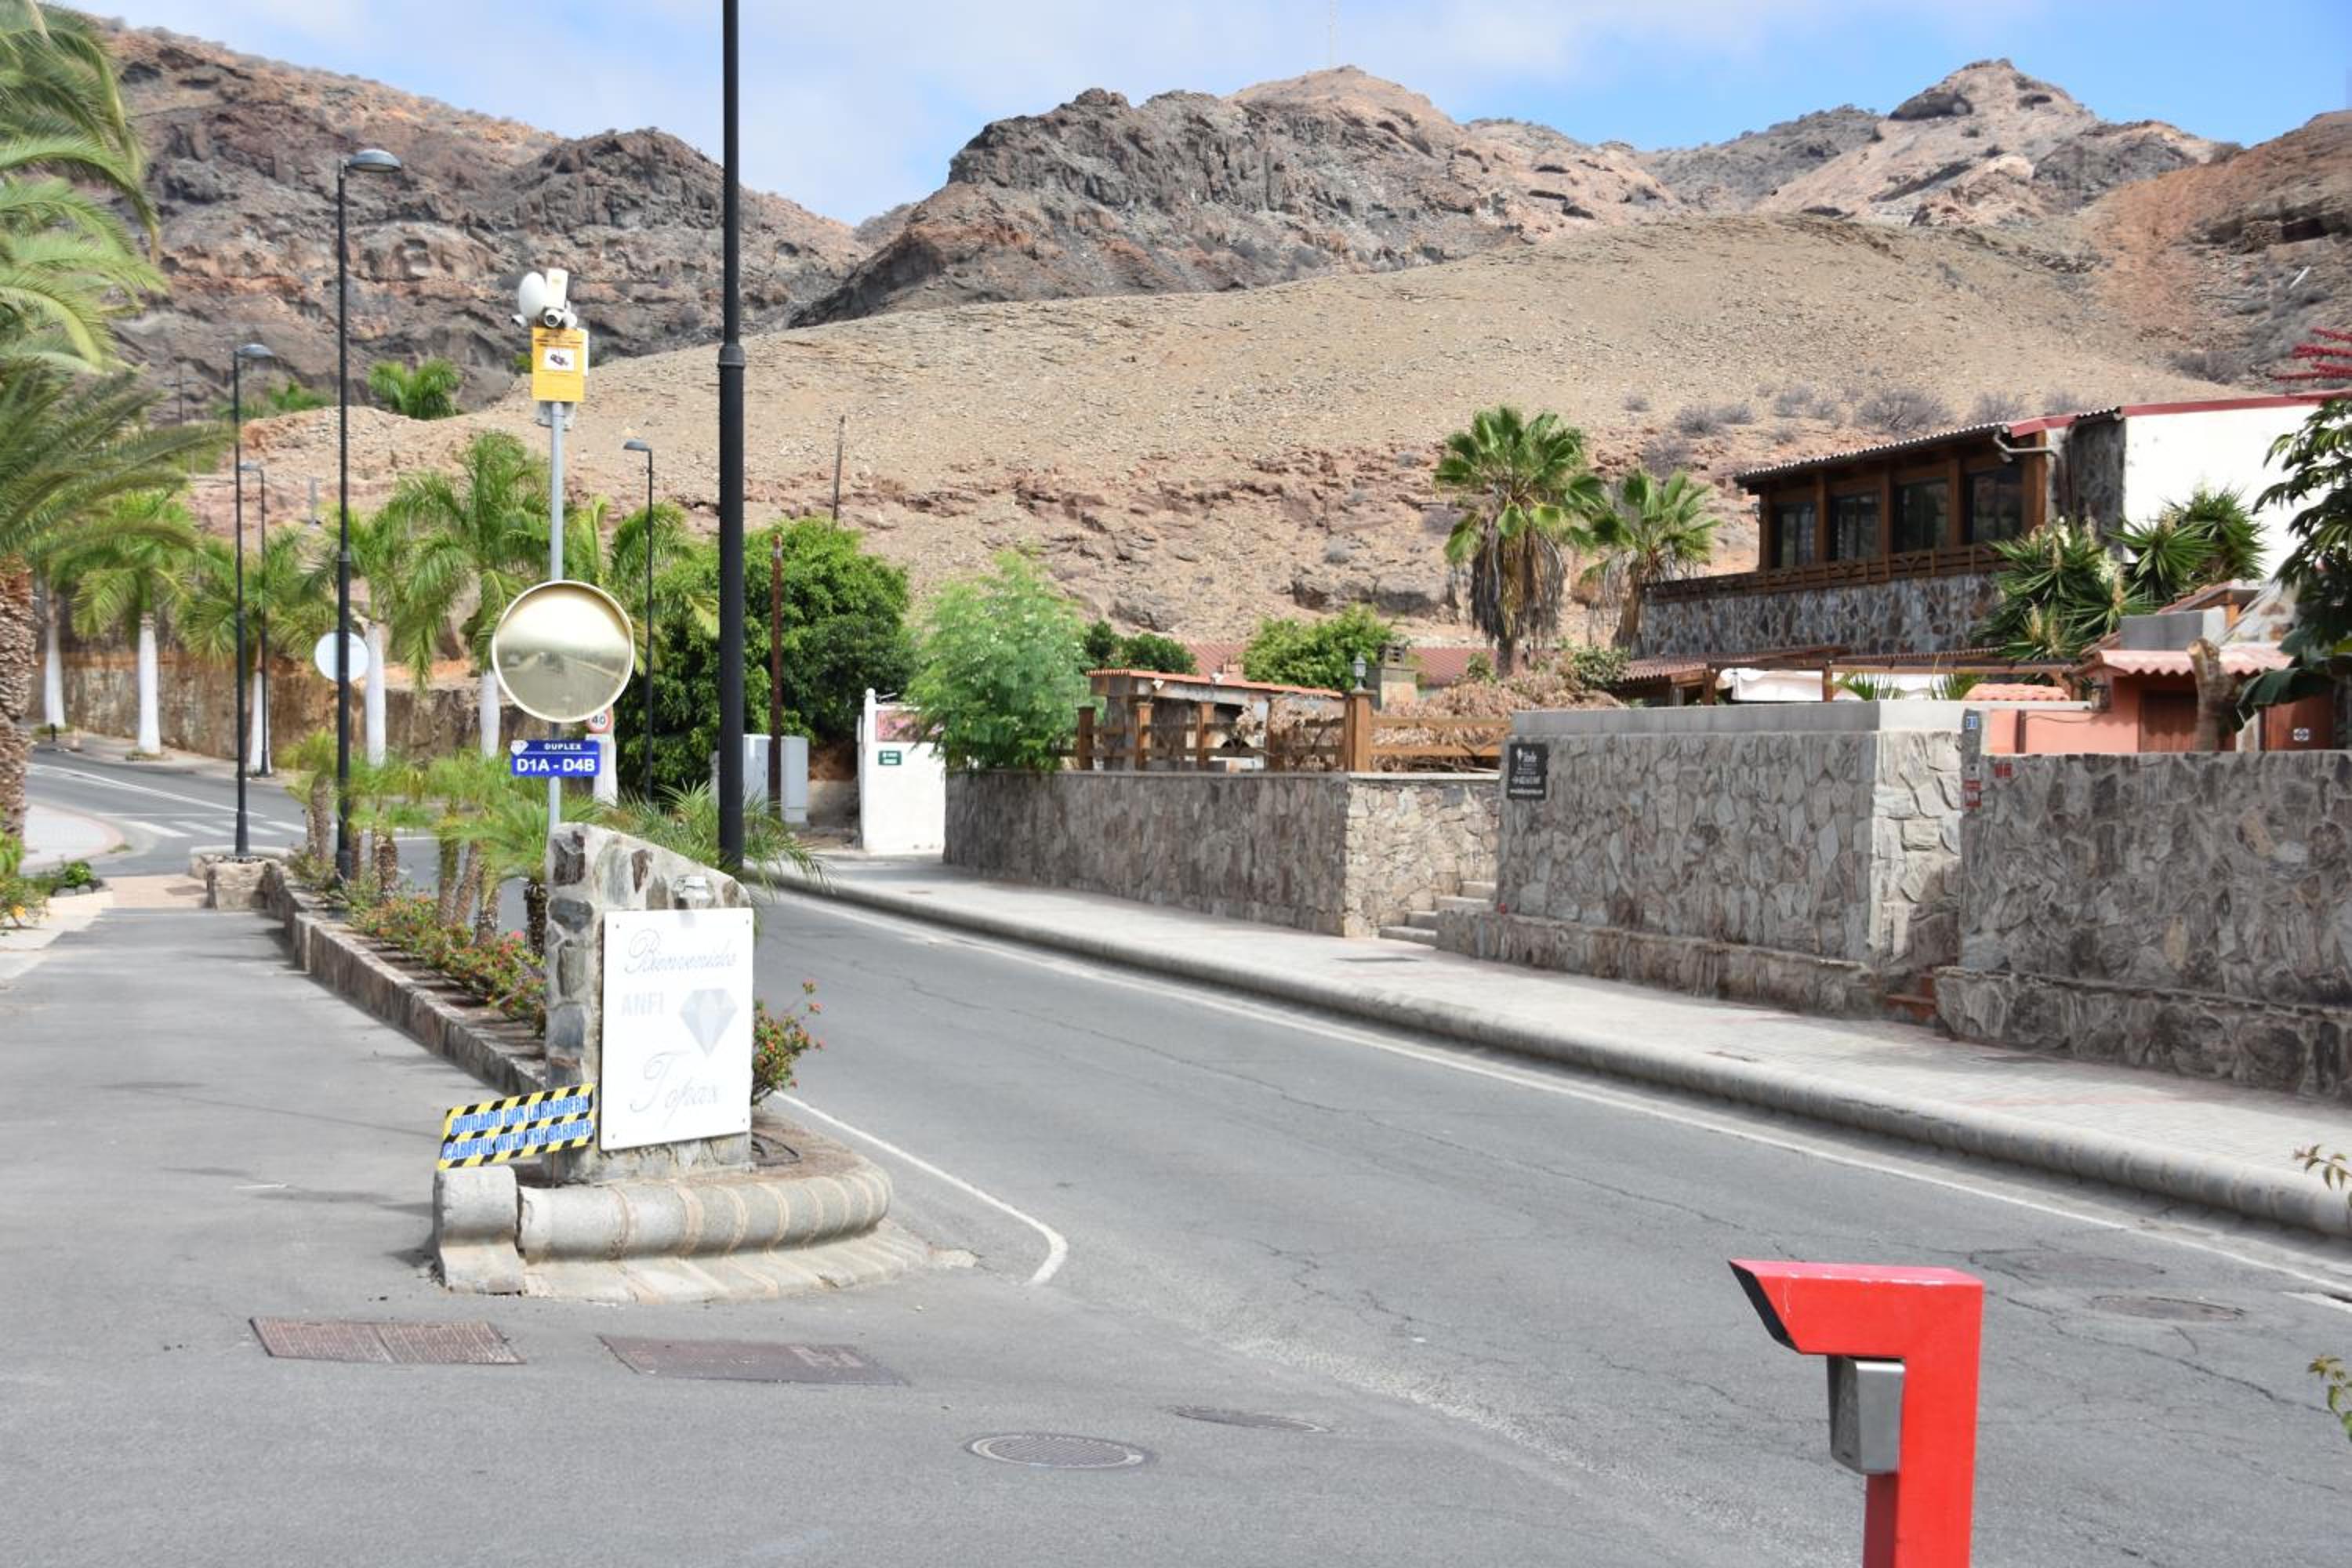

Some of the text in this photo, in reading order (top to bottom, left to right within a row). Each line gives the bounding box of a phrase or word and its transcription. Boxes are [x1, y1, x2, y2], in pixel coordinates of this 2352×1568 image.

[592, 714, 606, 724] 40
[517, 758, 550, 772] D1A
[562, 758, 596, 772] D4B
[621, 991, 665, 1017] ANFI
[452, 1095, 589, 1135] CUIDADO CON LA BARRERA
[442, 1119, 593, 1160] CAREFUL WITH THE BARRIER
